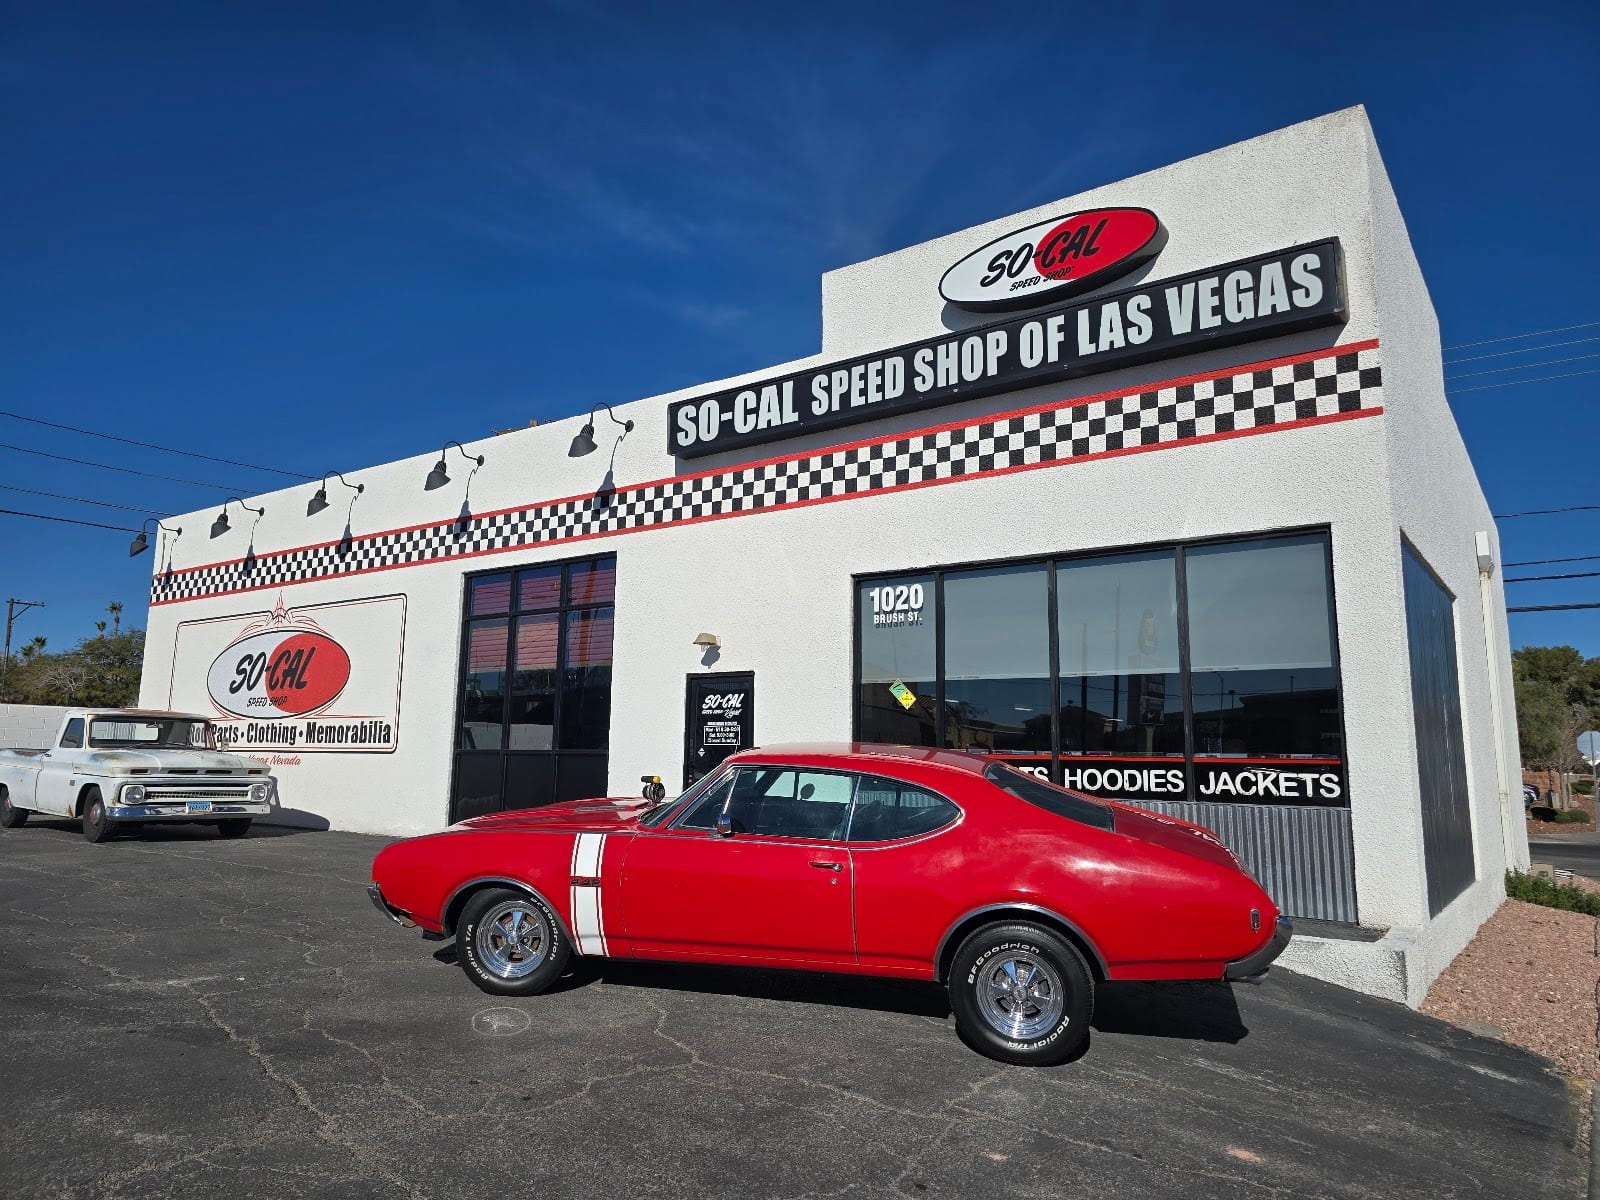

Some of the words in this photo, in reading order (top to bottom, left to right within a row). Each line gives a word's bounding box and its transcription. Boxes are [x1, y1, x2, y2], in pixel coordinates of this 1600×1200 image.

[980, 218, 1109, 288] SO-CAL
[1009, 276, 1041, 291] SPEED
[1042, 266, 1072, 282] SHOP
[676, 380, 799, 447] SO-CAL
[811, 356, 905, 416] SPEED
[913, 329, 1008, 393] SHOP
[1019, 315, 1066, 369] OF
[1077, 294, 1153, 356] LAS
[1164, 253, 1323, 336] VEGAS
[869, 583, 924, 612] 1020
[873, 613, 905, 624] BRUSH
[907, 611, 922, 622] ST.
[229, 647, 316, 694] SO-CAL
[247, 697, 267, 707] SPEED
[269, 696, 288, 707] SHOP
[702, 693, 745, 709] SO-CAL
[211, 724, 239, 744] Parts
[246, 722, 297, 746] Clothing
[305, 721, 391, 744] Memorabilia
[269, 755, 301, 766] Nevada
[1064, 767, 1184, 793] HOODIES
[1200, 771, 1341, 798] JACKETS
[967, 942, 1039, 984] BFGoodrich
[1034, 1015, 1070, 1048] Radial
